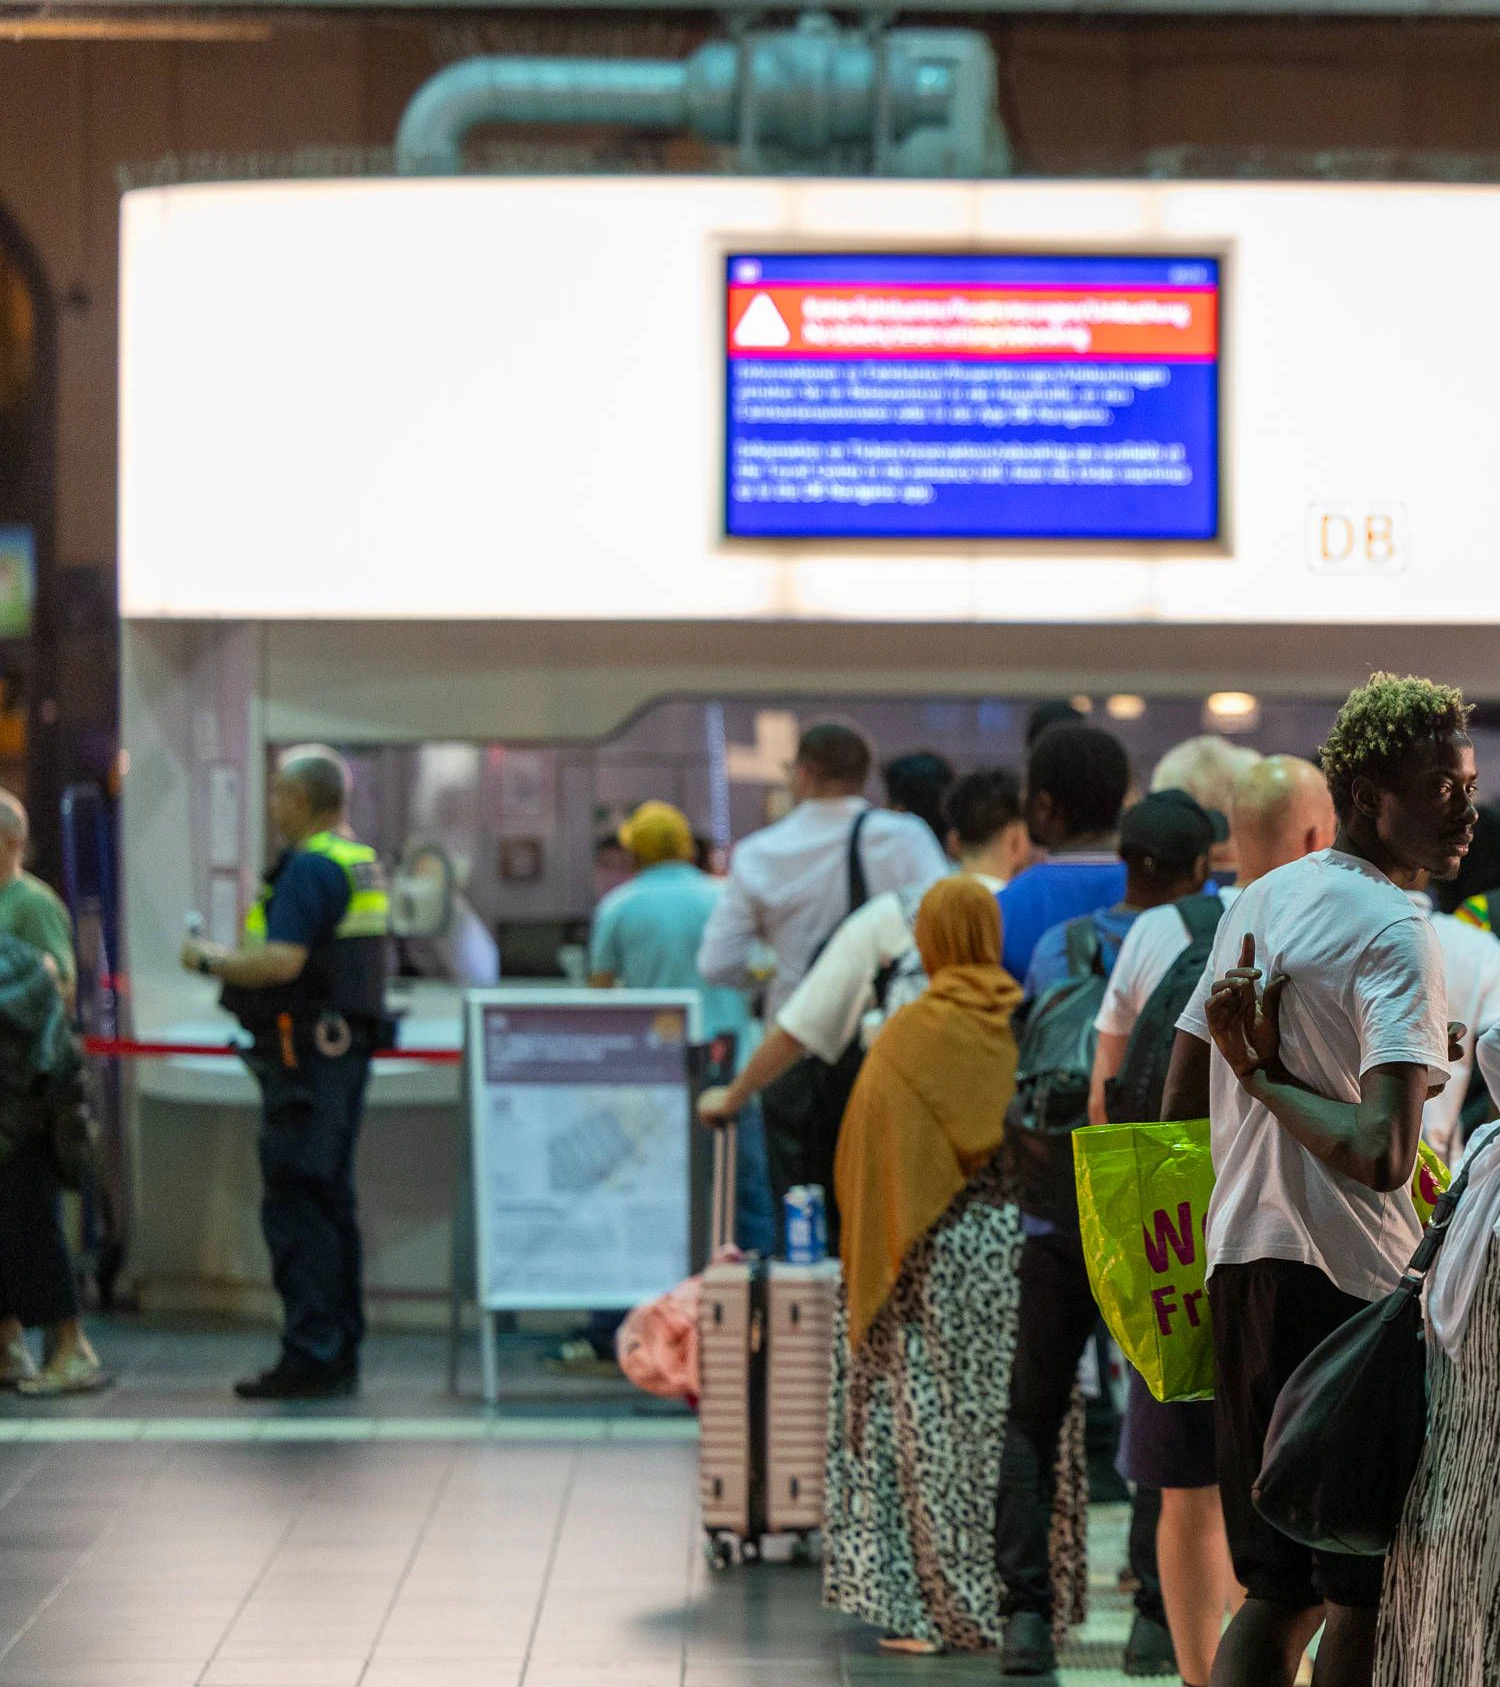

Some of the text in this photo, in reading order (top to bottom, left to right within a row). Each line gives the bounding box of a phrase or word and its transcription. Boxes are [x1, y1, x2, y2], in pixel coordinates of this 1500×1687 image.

[1318, 512, 1396, 562] DB
[1142, 1201, 1207, 1273] W
[1151, 1284, 1203, 1337] Fr
